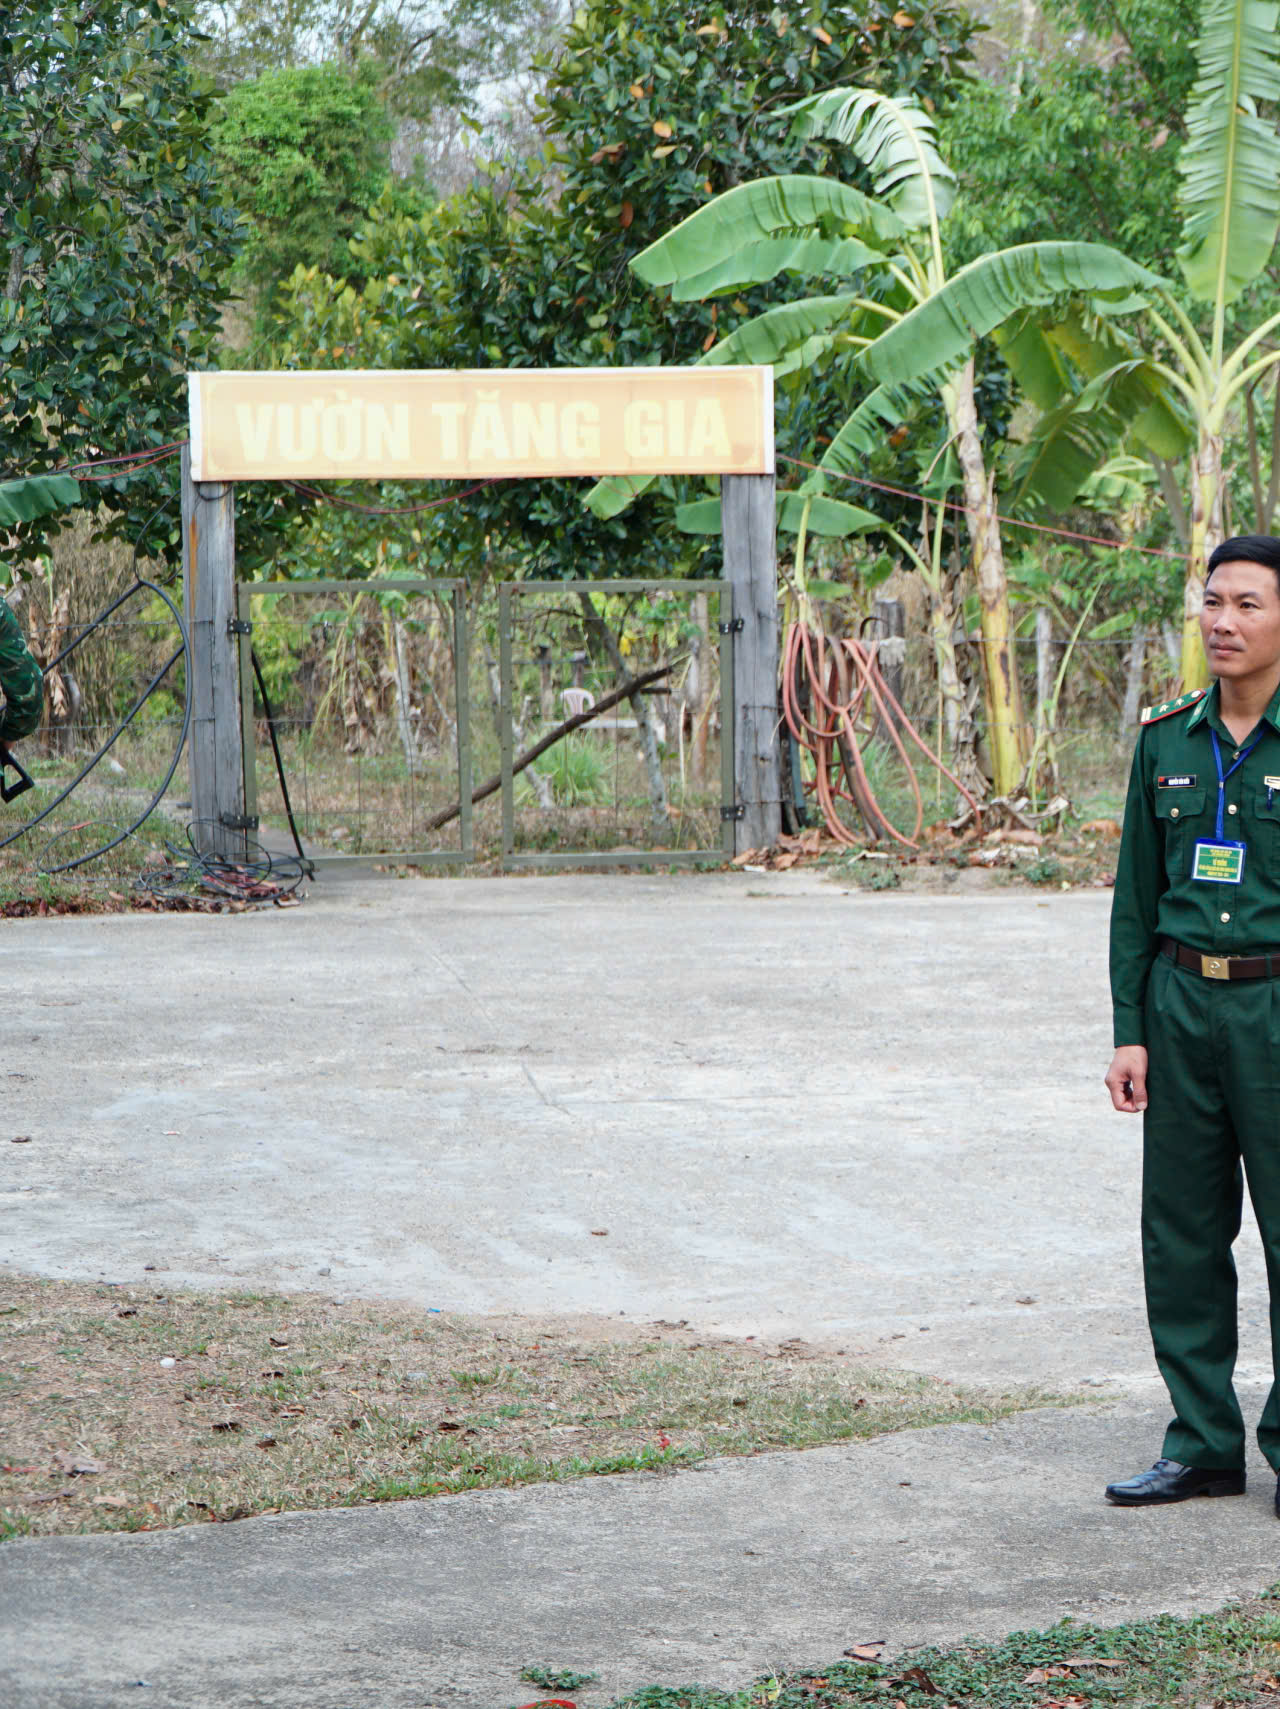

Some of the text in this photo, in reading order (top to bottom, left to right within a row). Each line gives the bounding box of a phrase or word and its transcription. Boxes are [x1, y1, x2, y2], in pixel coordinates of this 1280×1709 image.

[235, 389, 732, 462] VƯỜN TĂNG GIA
